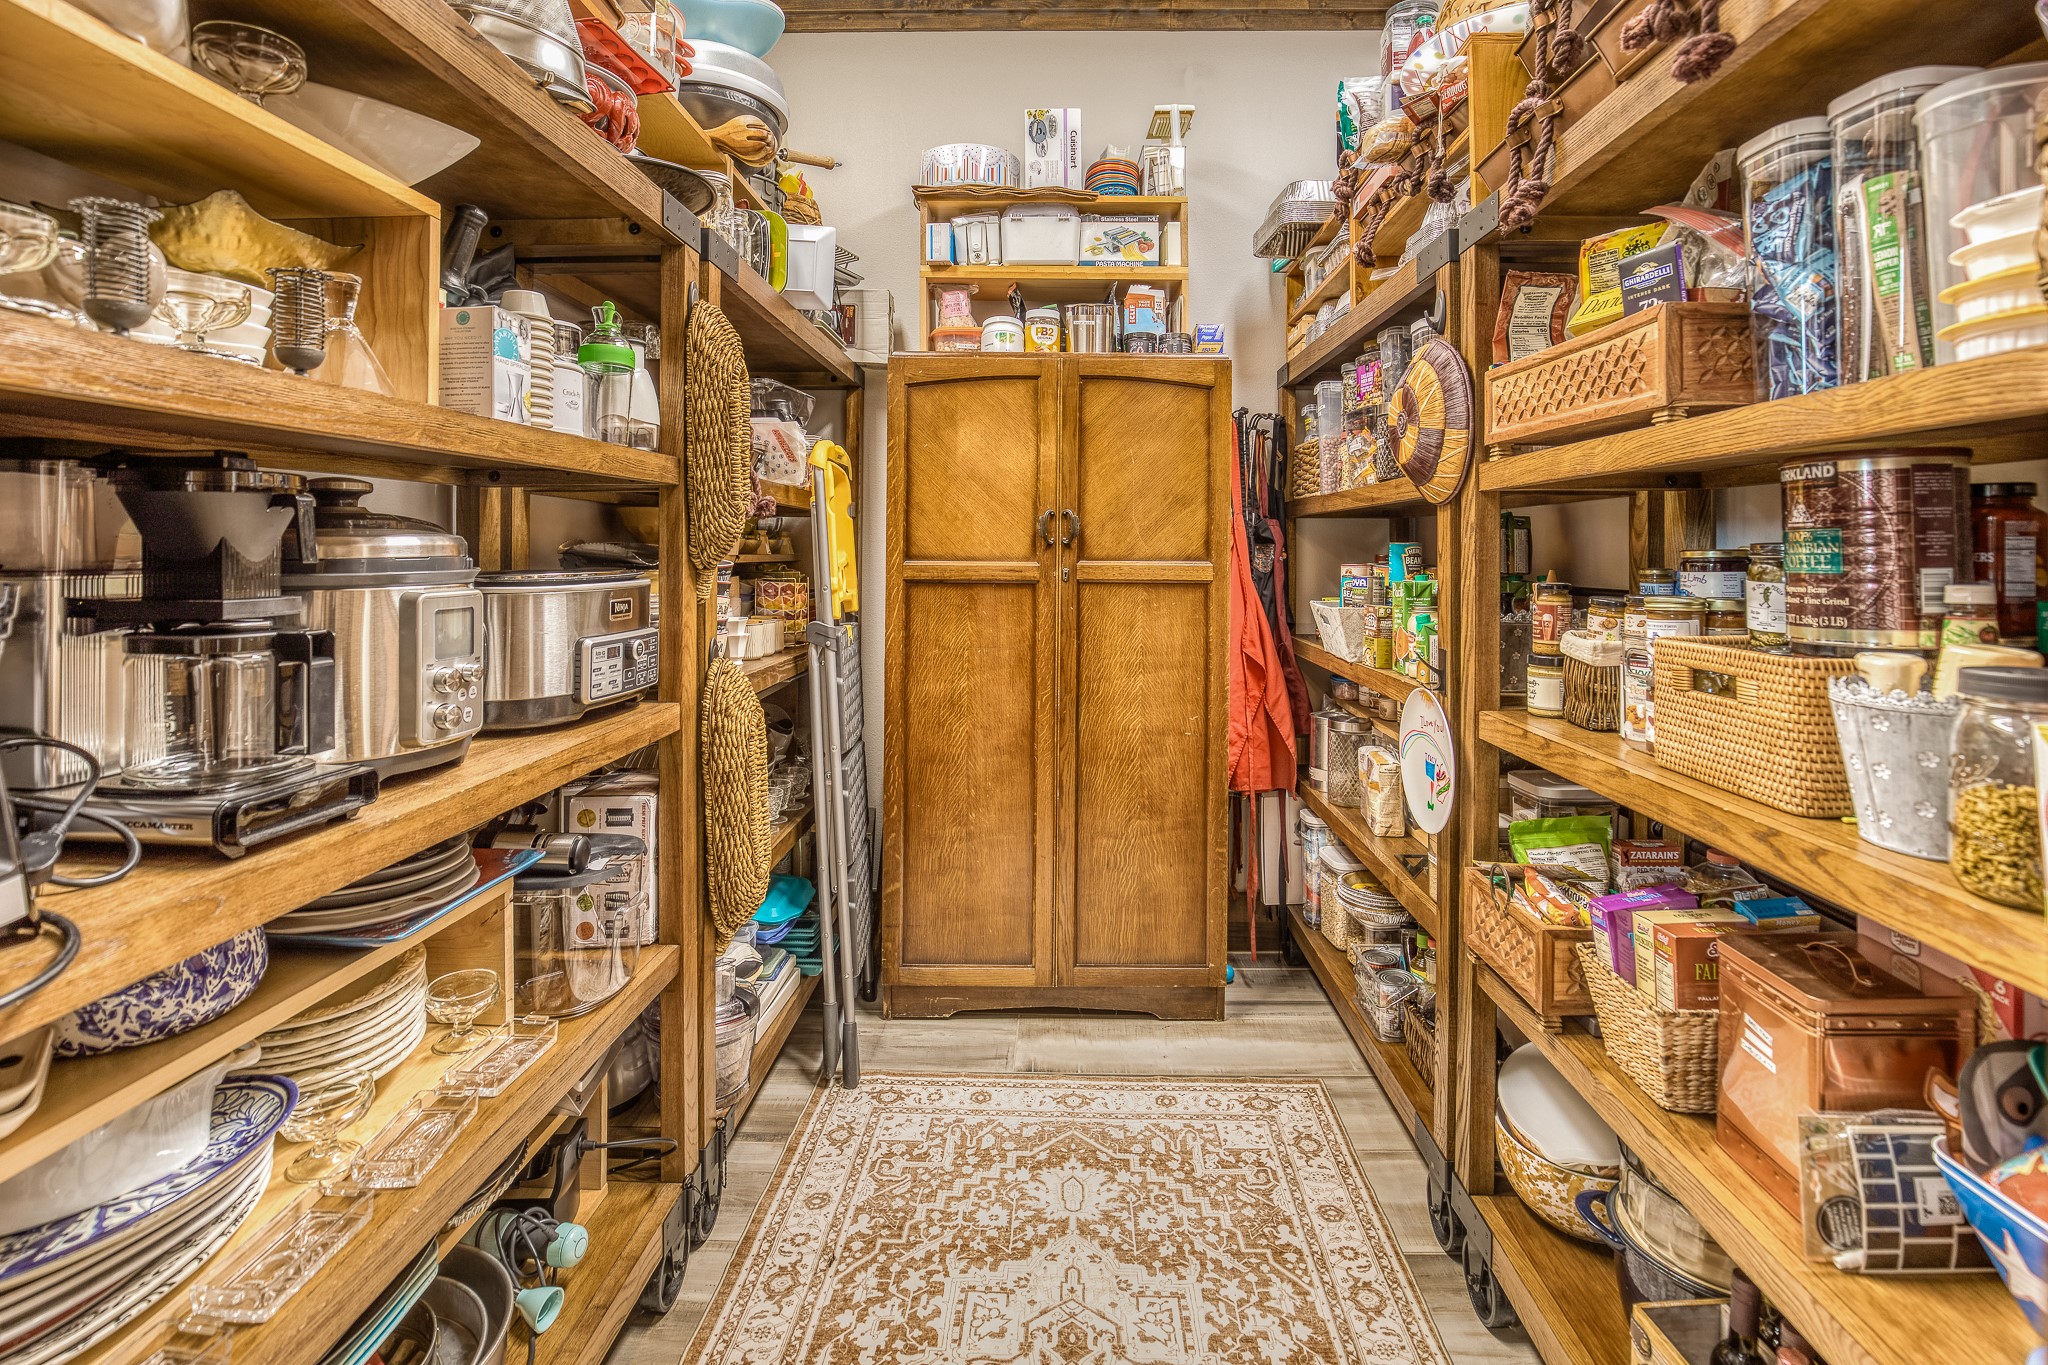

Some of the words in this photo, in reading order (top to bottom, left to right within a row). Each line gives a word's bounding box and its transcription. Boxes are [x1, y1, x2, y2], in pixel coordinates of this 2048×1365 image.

[1070, 130, 1078, 169] Cuisinart
[1589, 252, 1607, 260] Nutrition
[1624, 266, 1671, 288] GHIRARDELLI
[1628, 290, 1651, 301] INTENSE
[1653, 284, 1671, 293] DARK
[1035, 327, 1054, 336] PB2
[1687, 573, 1708, 584] Limb
[1807, 586, 1828, 594] Bean
[1804, 597, 1821, 605] Fine
[1821, 597, 1850, 606] Grind
[1819, 616, 1829, 627] (3
[1830, 616, 1848, 628] LB)
[121, 820, 194, 830] OCCAMASTER
[1631, 851, 1680, 860] ZATARAIN'S
[1994, 980, 2006, 995] 6
